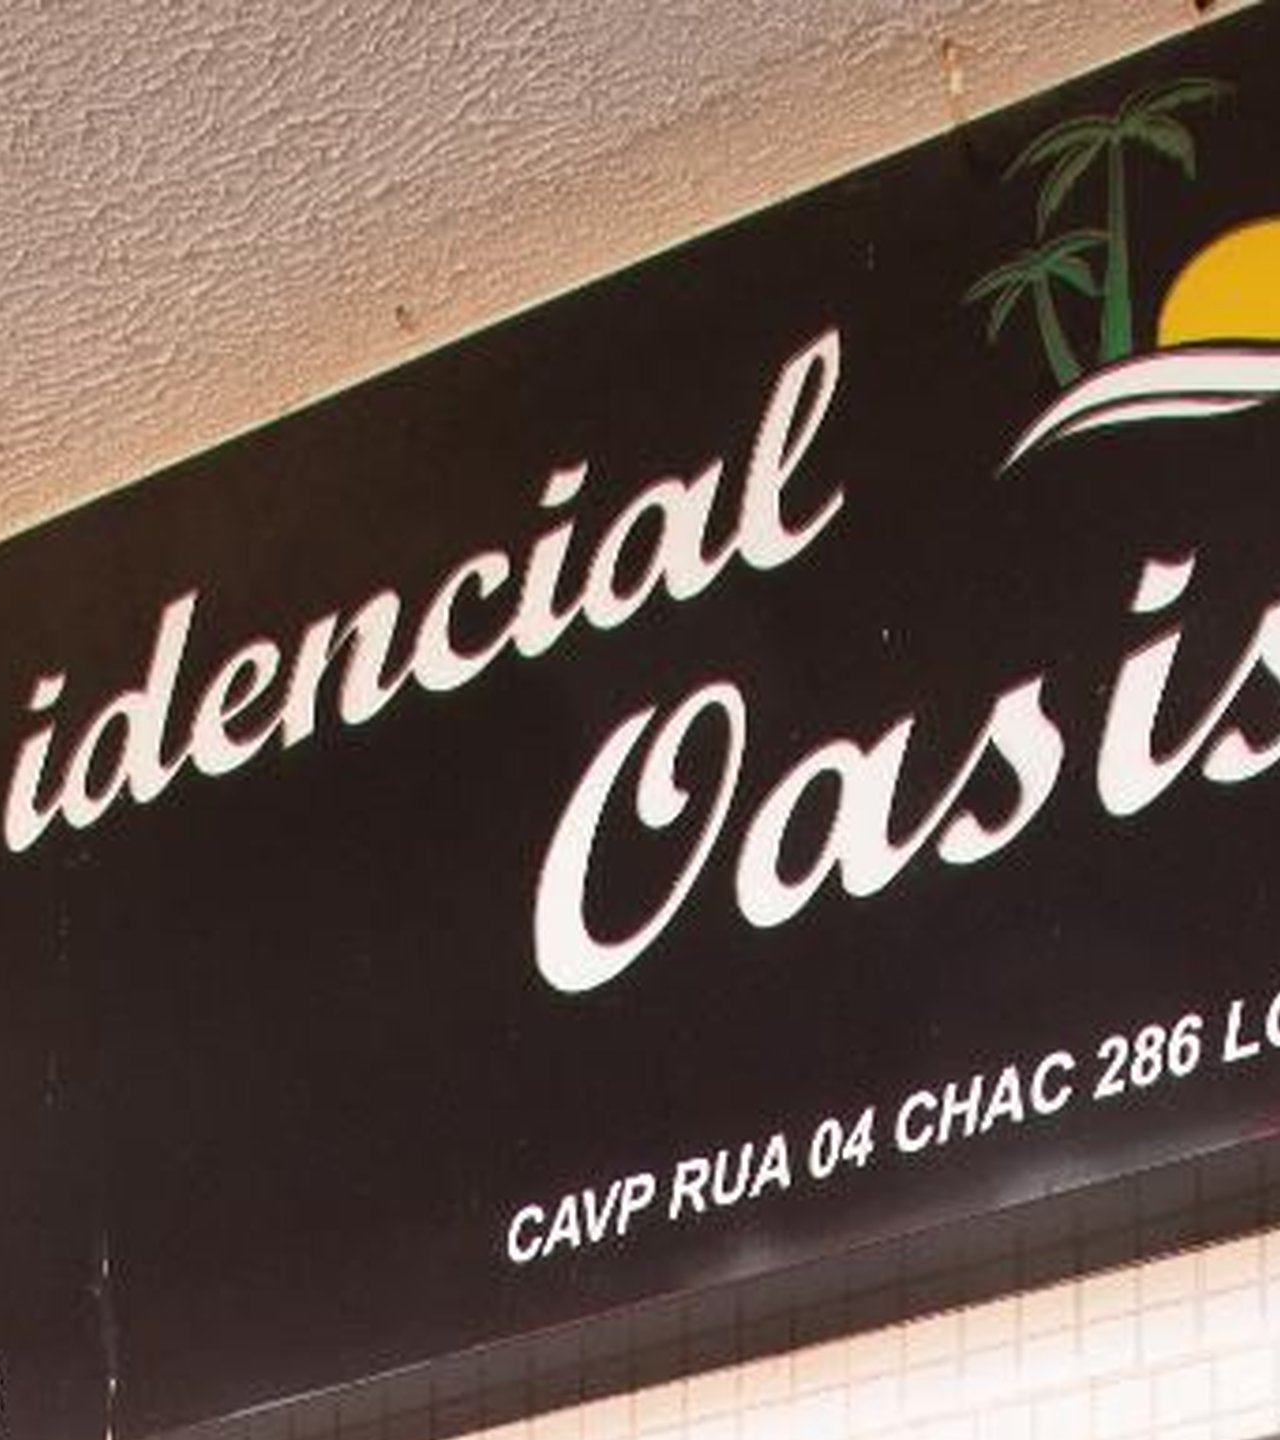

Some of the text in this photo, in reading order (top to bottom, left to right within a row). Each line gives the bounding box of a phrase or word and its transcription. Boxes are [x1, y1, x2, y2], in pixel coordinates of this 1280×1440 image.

[507, 1172, 656, 1264] CAVP
[668, 1133, 791, 1221] RUA
[808, 1106, 875, 1179] 04
[894, 1050, 1077, 1153] CHAC
[1092, 1012, 1204, 1101] 286
